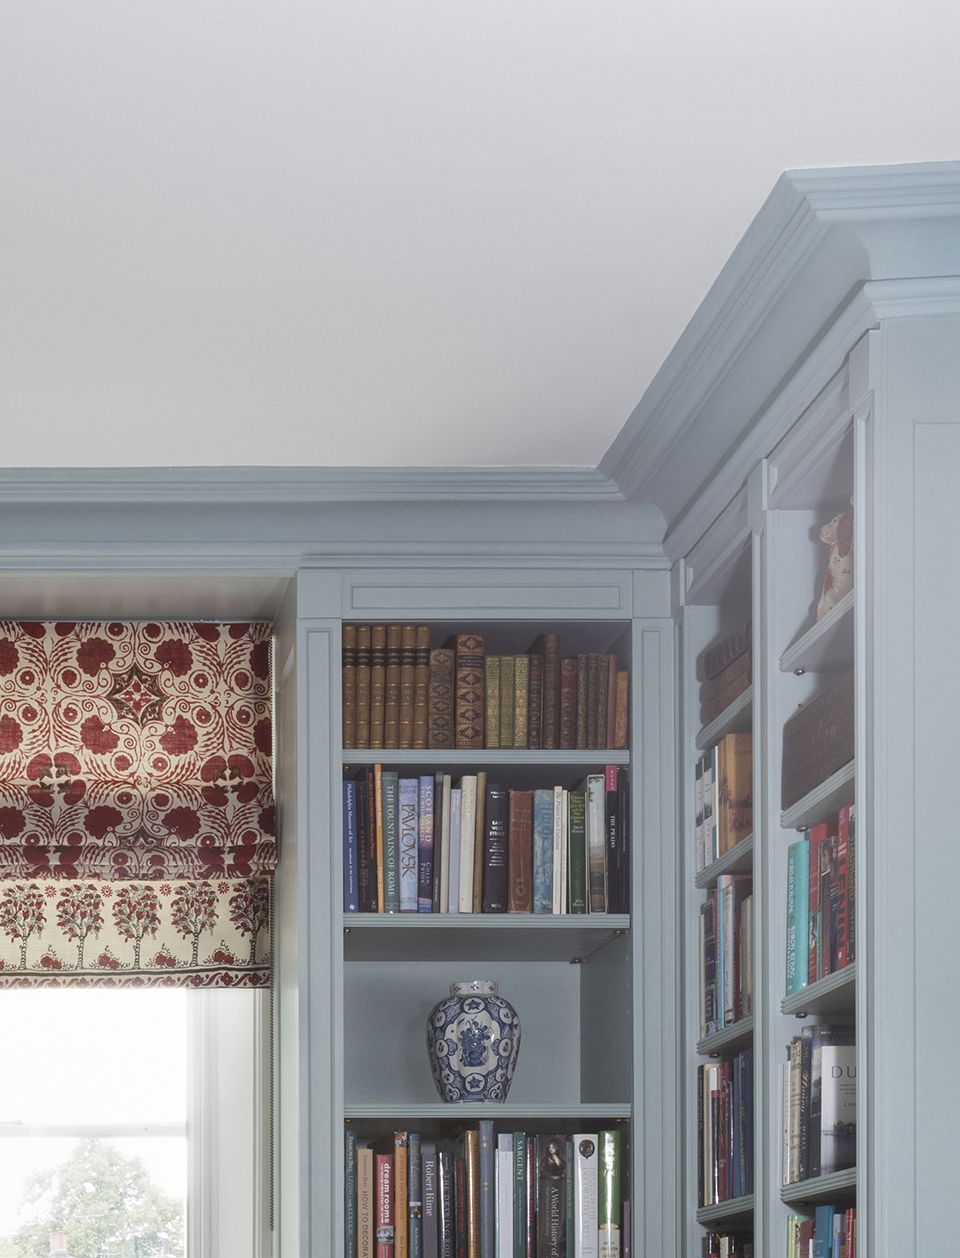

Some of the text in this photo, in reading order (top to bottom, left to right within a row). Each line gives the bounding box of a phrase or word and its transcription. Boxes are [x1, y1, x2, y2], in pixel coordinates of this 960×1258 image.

[386, 784, 394, 897] THE FOUNTAINS OF ROME
[401, 803, 416, 879] PAVLOVSK
[516, 1140, 524, 1182] SARGENT
[383, 1163, 391, 1224] dream rooms
[424, 1160, 434, 1217] Robert Kime
[443, 1174, 451, 1193] THE
[551, 1186, 559, 1194] A
[361, 1190, 369, 1210] HOW
[551, 1194, 559, 1218] World
[361, 1212, 369, 1223] TO
[443, 1194, 451, 1237] DRAWING
[549, 1218, 559, 1247] History
[551, 1247, 559, 1256] of
